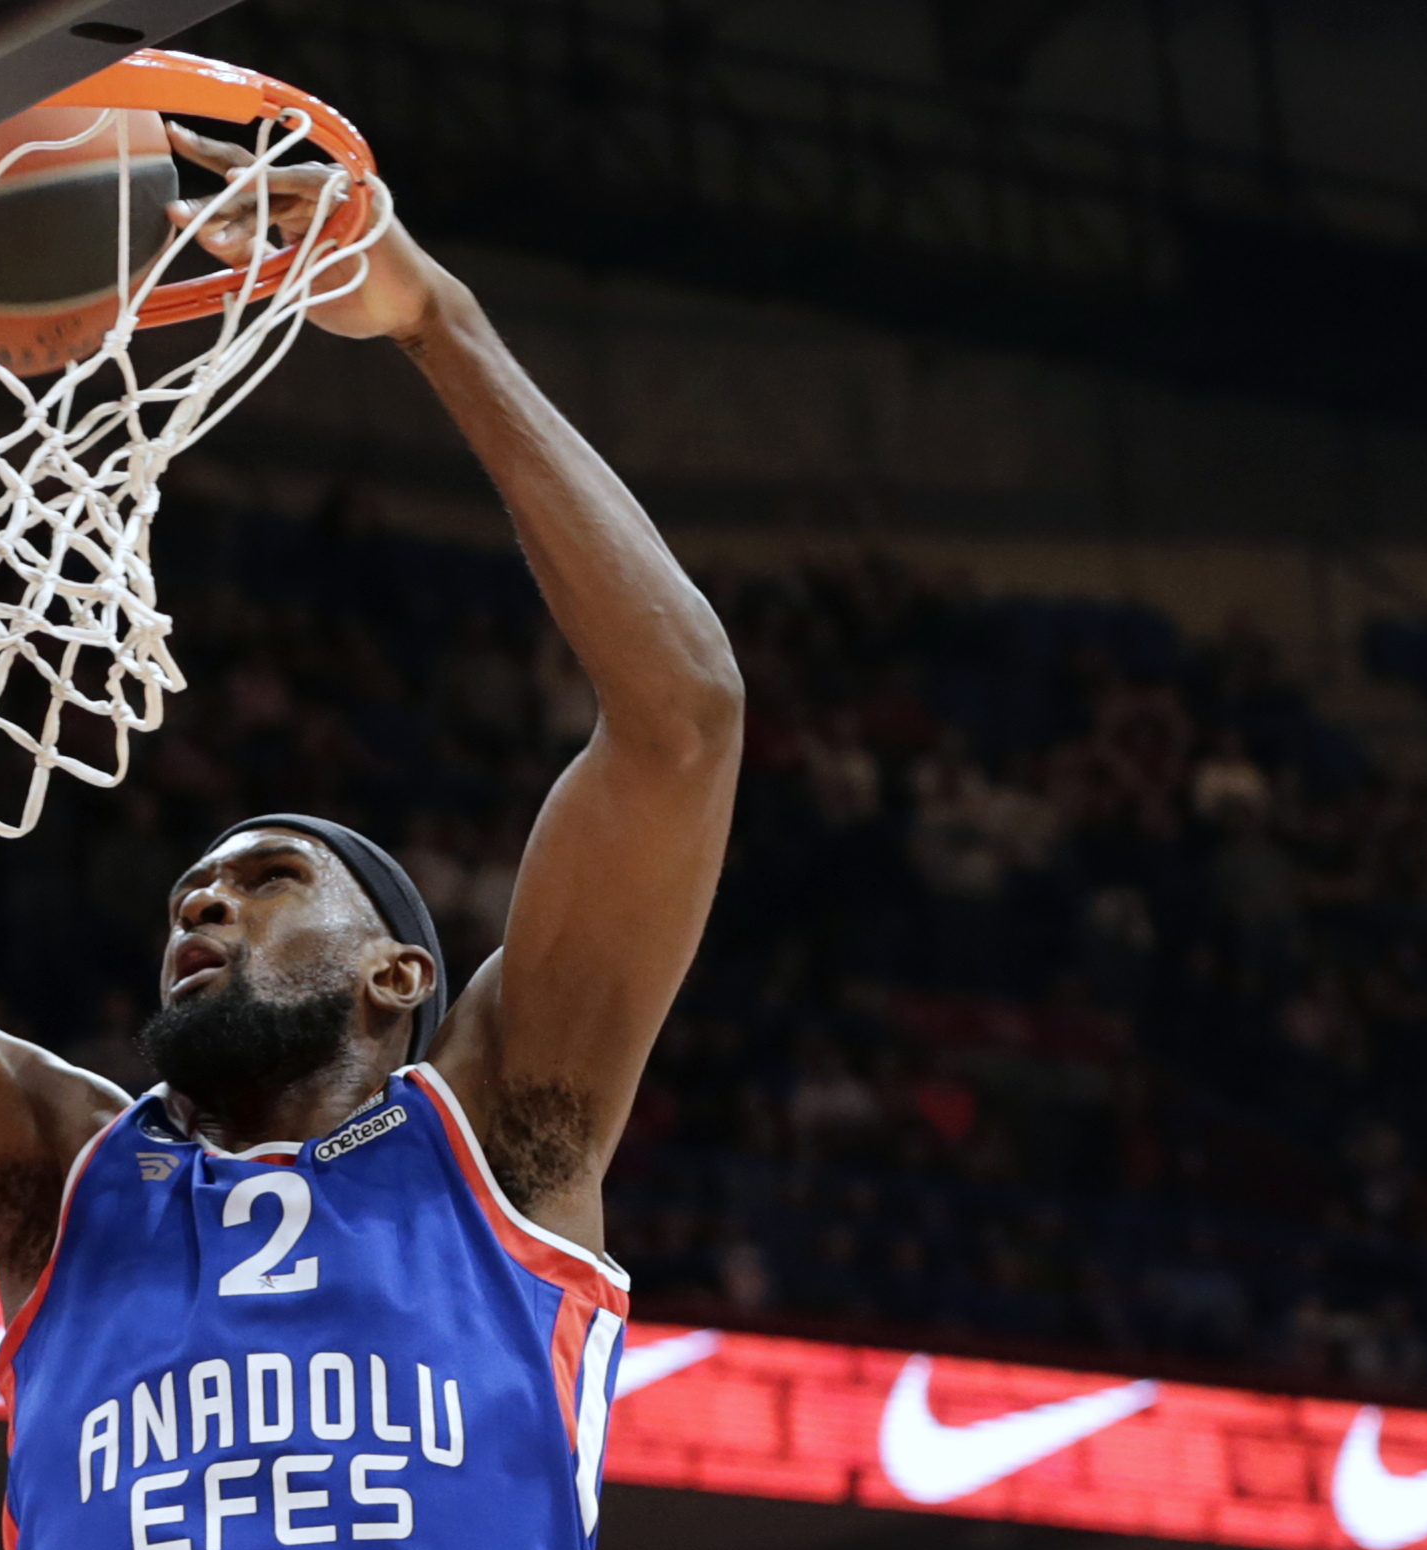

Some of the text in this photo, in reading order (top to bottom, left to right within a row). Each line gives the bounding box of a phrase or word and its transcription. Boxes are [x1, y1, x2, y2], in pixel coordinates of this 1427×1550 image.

[318, 1108, 404, 1159] oneteam
[218, 1170, 319, 1296] 2
[79, 1351, 464, 1503] ANADOLU
